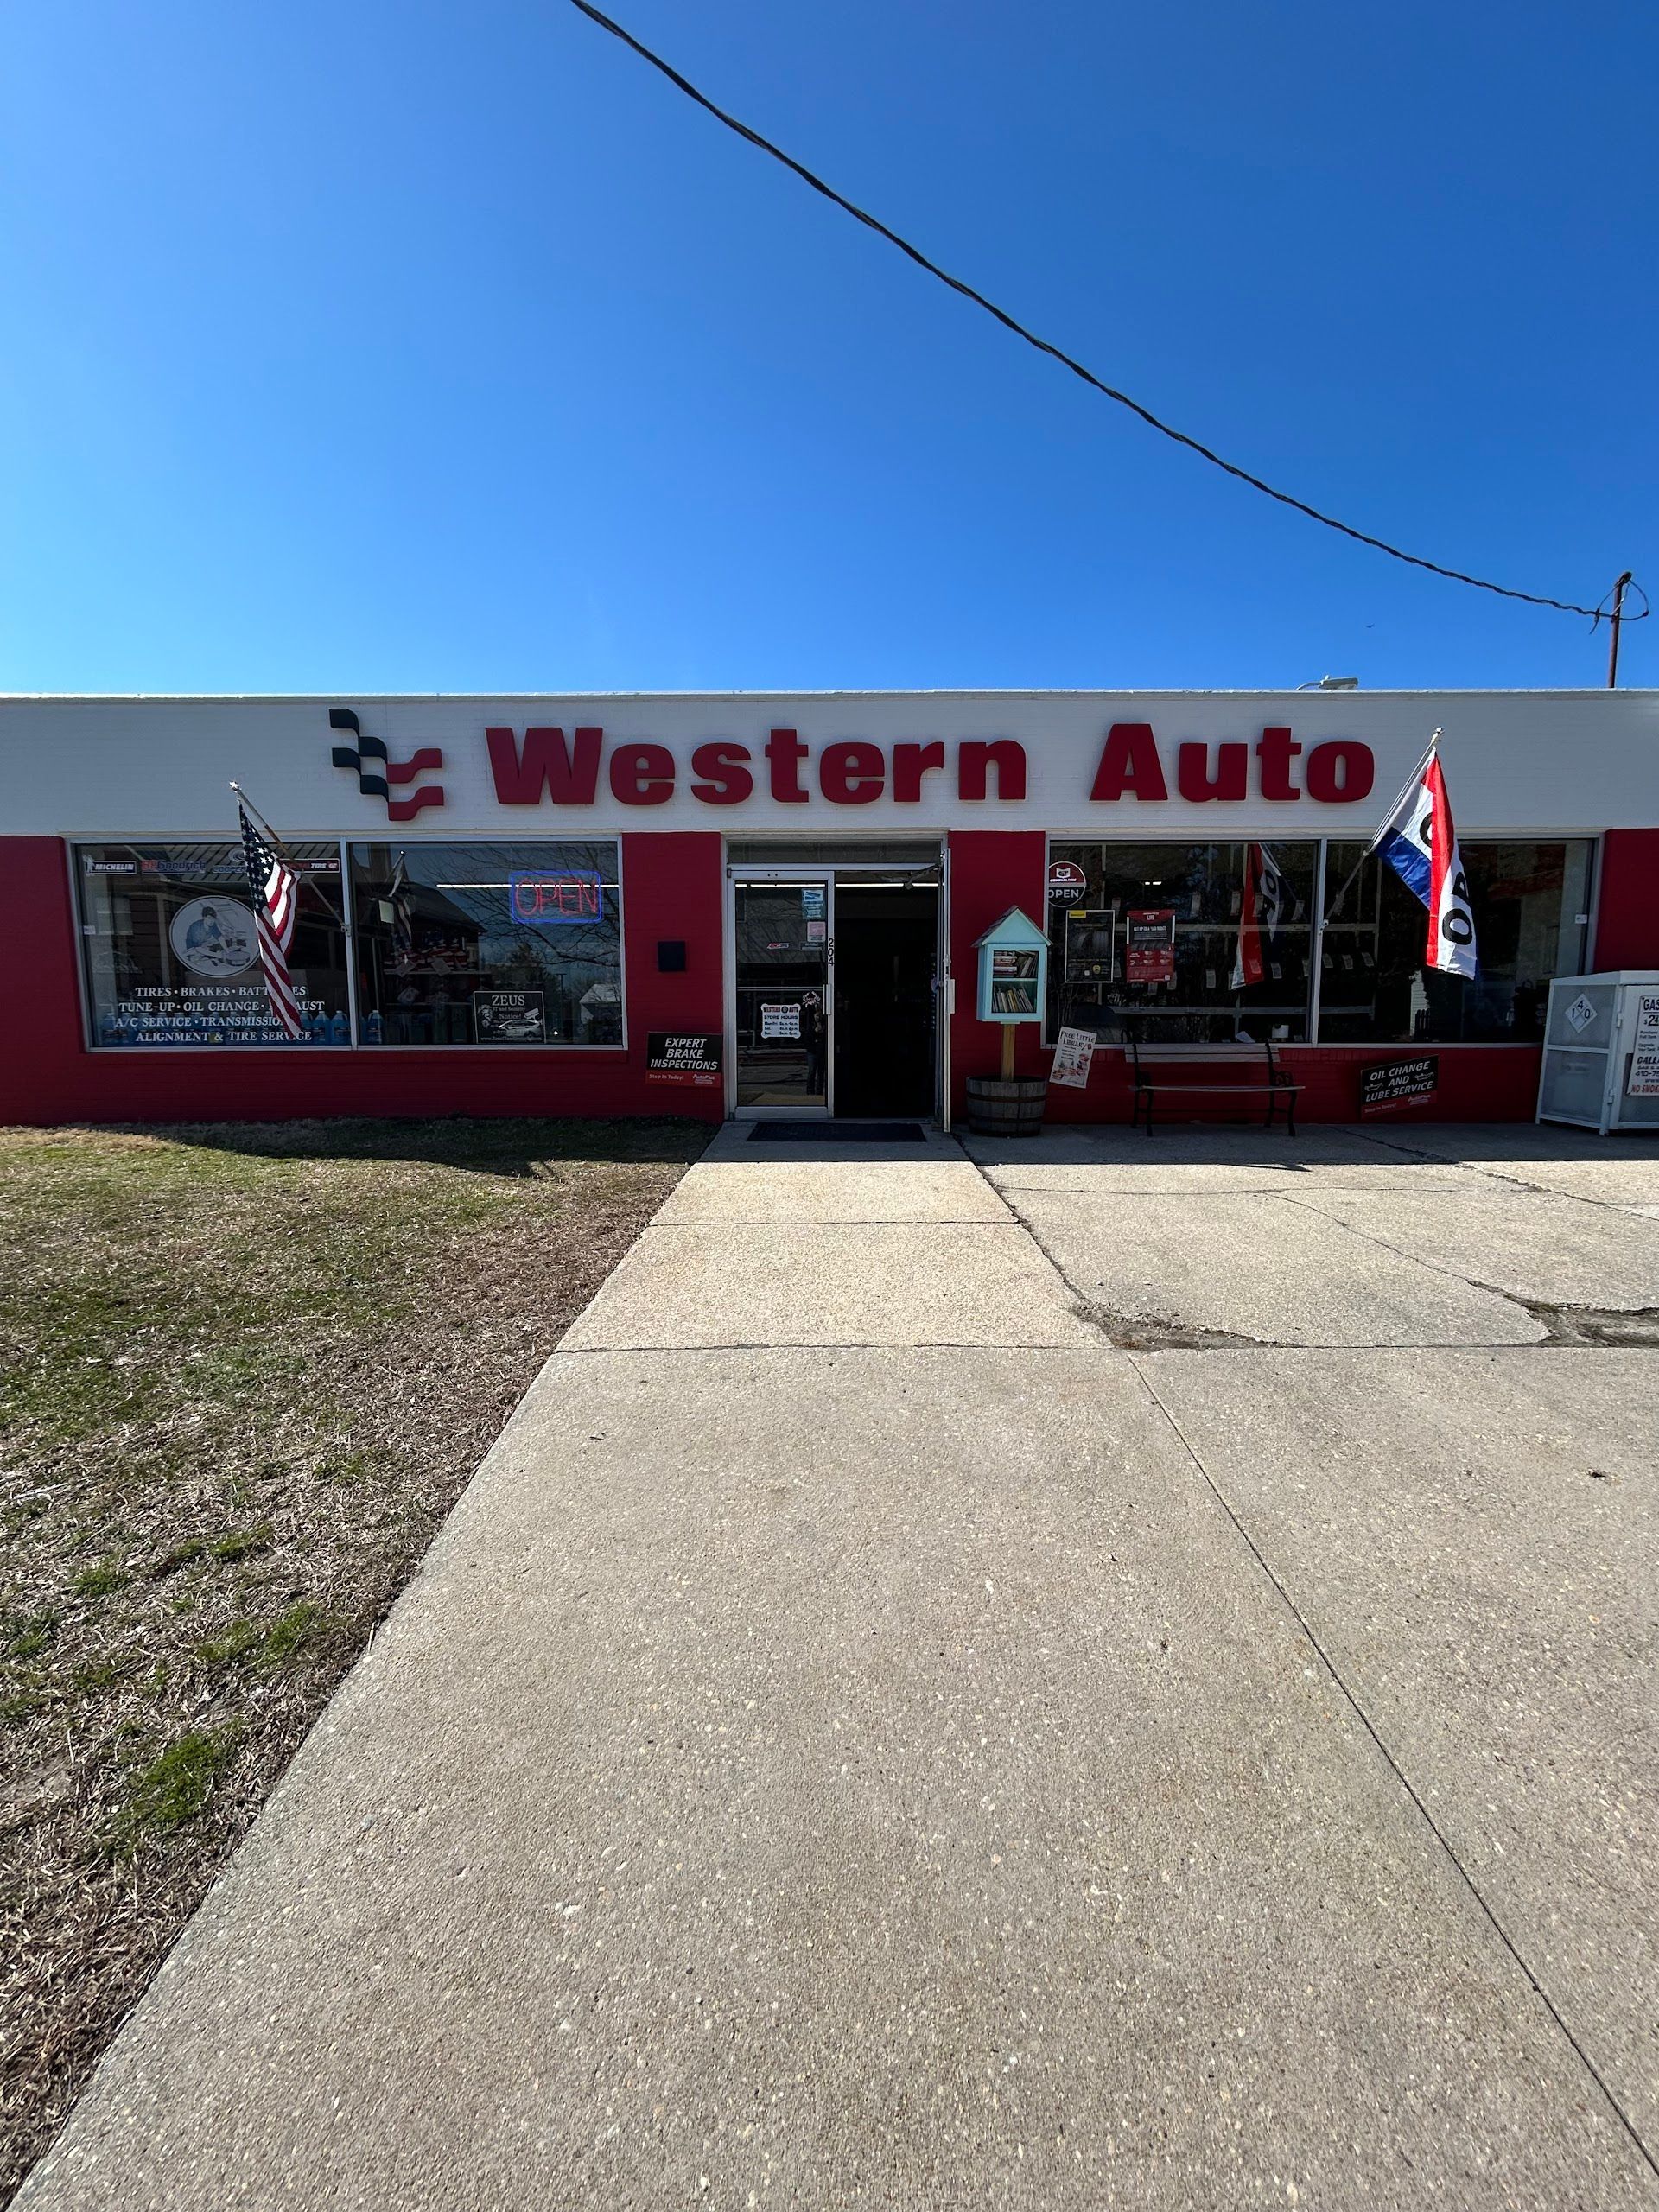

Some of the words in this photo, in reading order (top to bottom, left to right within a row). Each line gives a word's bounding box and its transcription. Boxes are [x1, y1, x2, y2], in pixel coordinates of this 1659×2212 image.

[486, 727, 1026, 805] Western
[1089, 723, 1375, 803] Auto
[141, 861, 206, 871] BFGoodrich
[514, 877, 598, 916] OPEN
[1048, 889, 1079, 899] OPEN
[135, 987, 172, 996] TIRES
[181, 987, 230, 996] BRAKES
[238, 986, 307, 996] BATTES
[491, 995, 525, 1006] ZEUS
[1577, 1000, 1584, 1009] 4
[118, 1002, 175, 1012] TUNE-UP
[183, 1002, 205, 1012] OIL
[207, 1001, 259, 1012] CHANGE
[115, 1017, 138, 1027] A/C
[142, 1017, 192, 1027] SERVICE
[200, 1016, 284, 1027] TRANSMISSIO
[135, 1032, 210, 1042] ALIGNMENT
[213, 1032, 224, 1042] &
[227, 1031, 257, 1041] TIRE
[1060, 1031, 1076, 1039] FREE
[664, 1038, 708, 1048] EXPERT
[666, 1048, 705, 1058] BRAKE
[650, 1058, 719, 1070] INSPECTIONS
[1370, 1071, 1387, 1081] OIL
[1389, 1061, 1431, 1077] CHANGE
[1388, 1076, 1409, 1087] AND
[1365, 1090, 1391, 1103] LUBE
[1391, 1081, 1434, 1096] SERVICE
